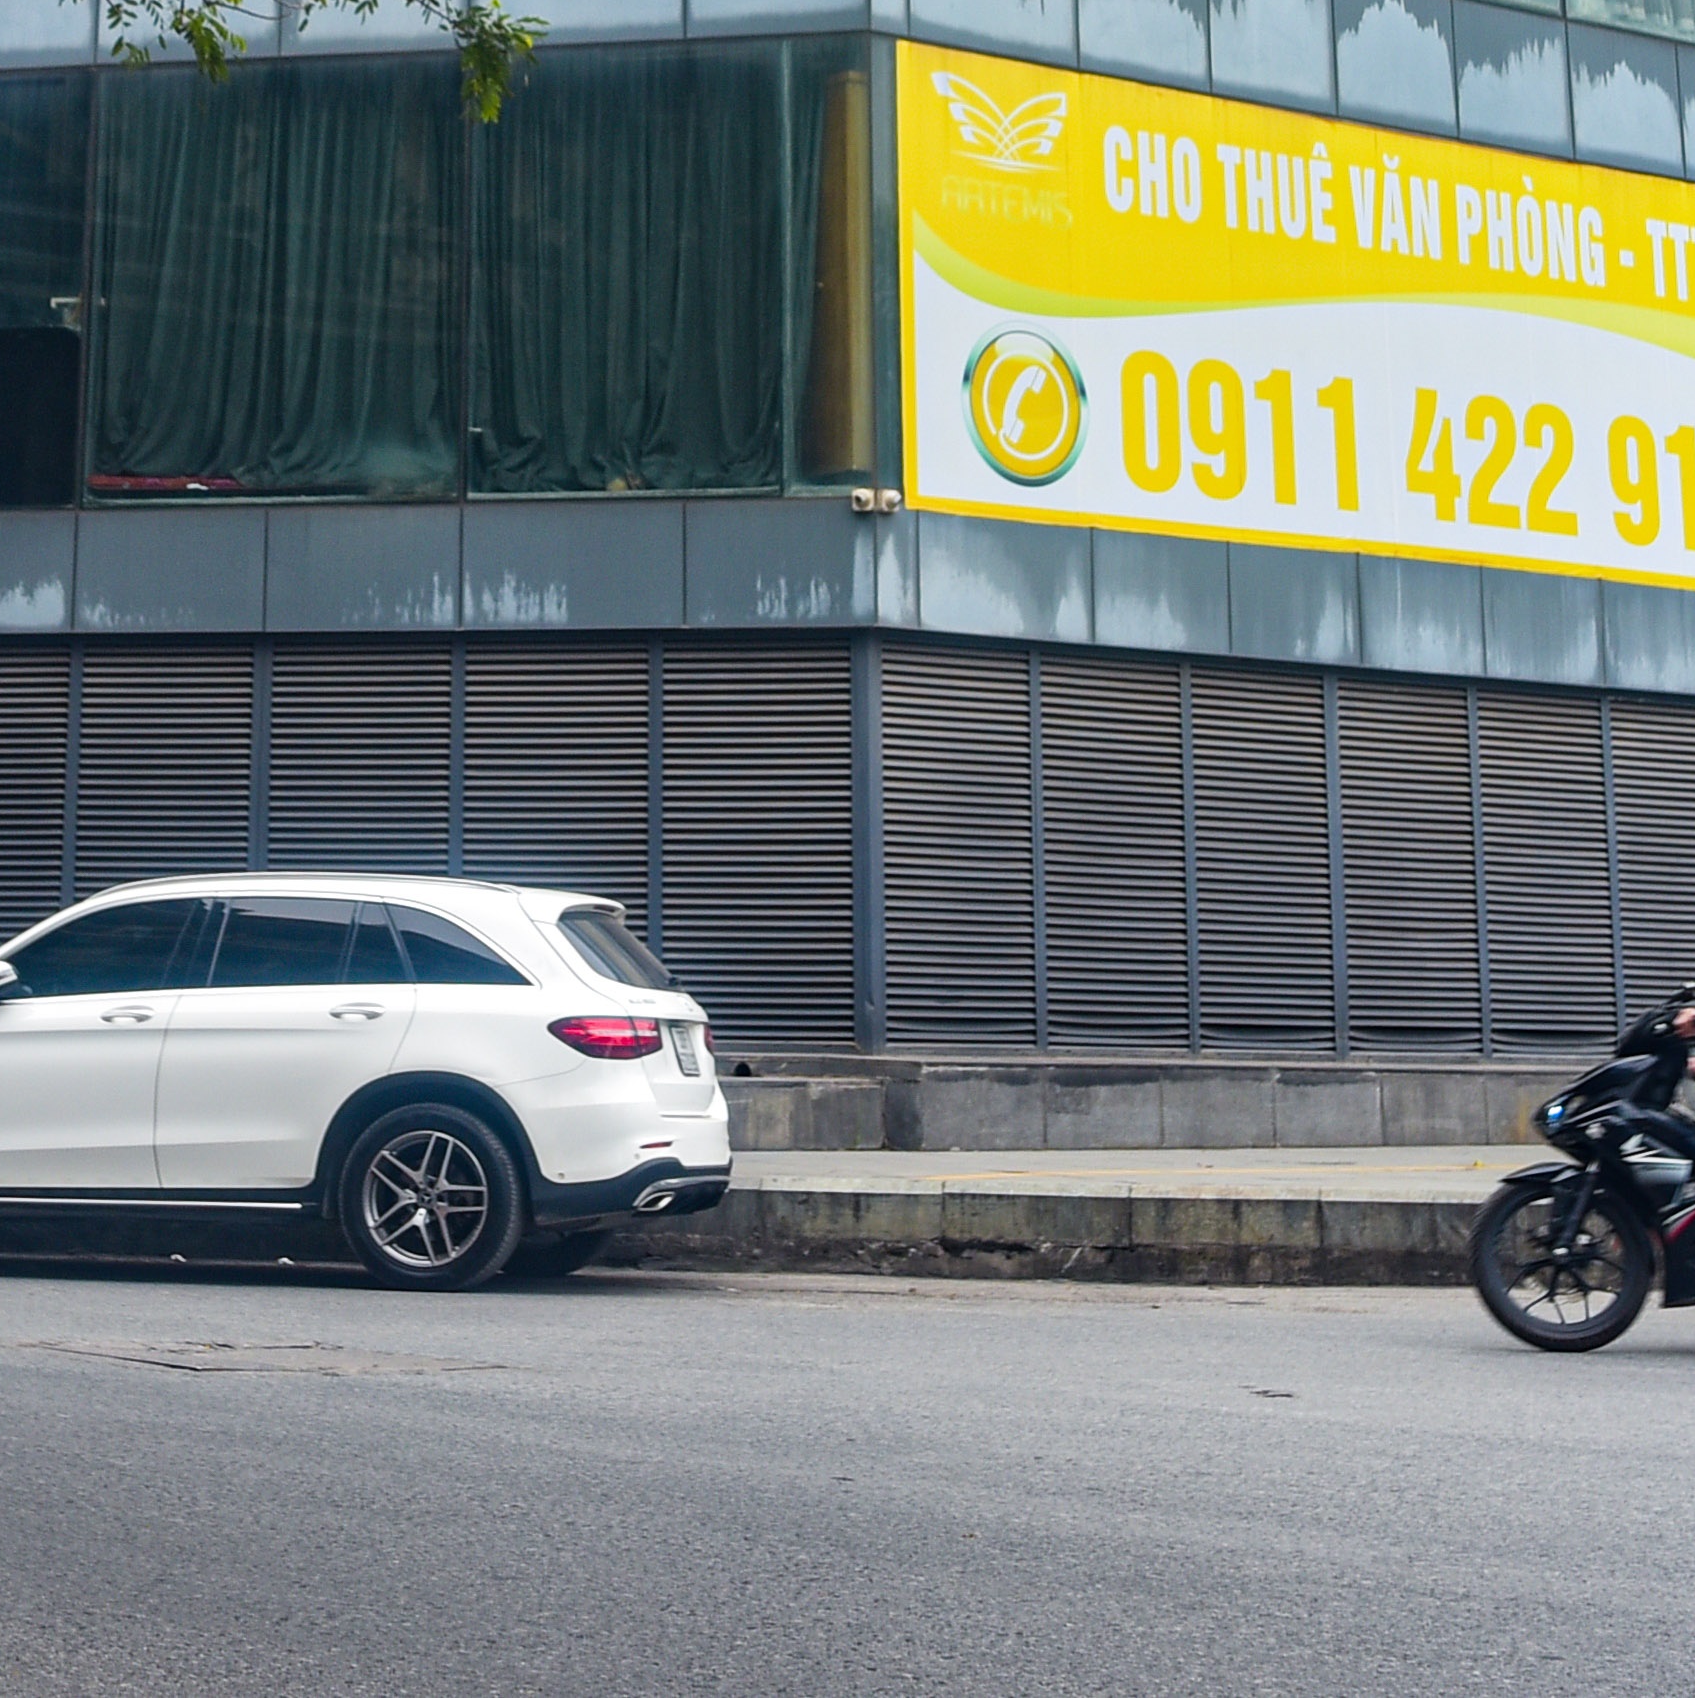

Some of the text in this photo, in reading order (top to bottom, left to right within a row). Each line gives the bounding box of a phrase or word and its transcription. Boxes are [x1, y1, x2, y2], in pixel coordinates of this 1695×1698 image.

[1104, 125, 1202, 223] CHO
[1216, 141, 1337, 243] THUÊ
[1348, 153, 1443, 261] VĂN
[1454, 175, 1606, 287] PHÒNG
[1618, 248, 1635, 268] -
[1120, 349, 1359, 512] 0911
[1404, 386, 1579, 536] 422
